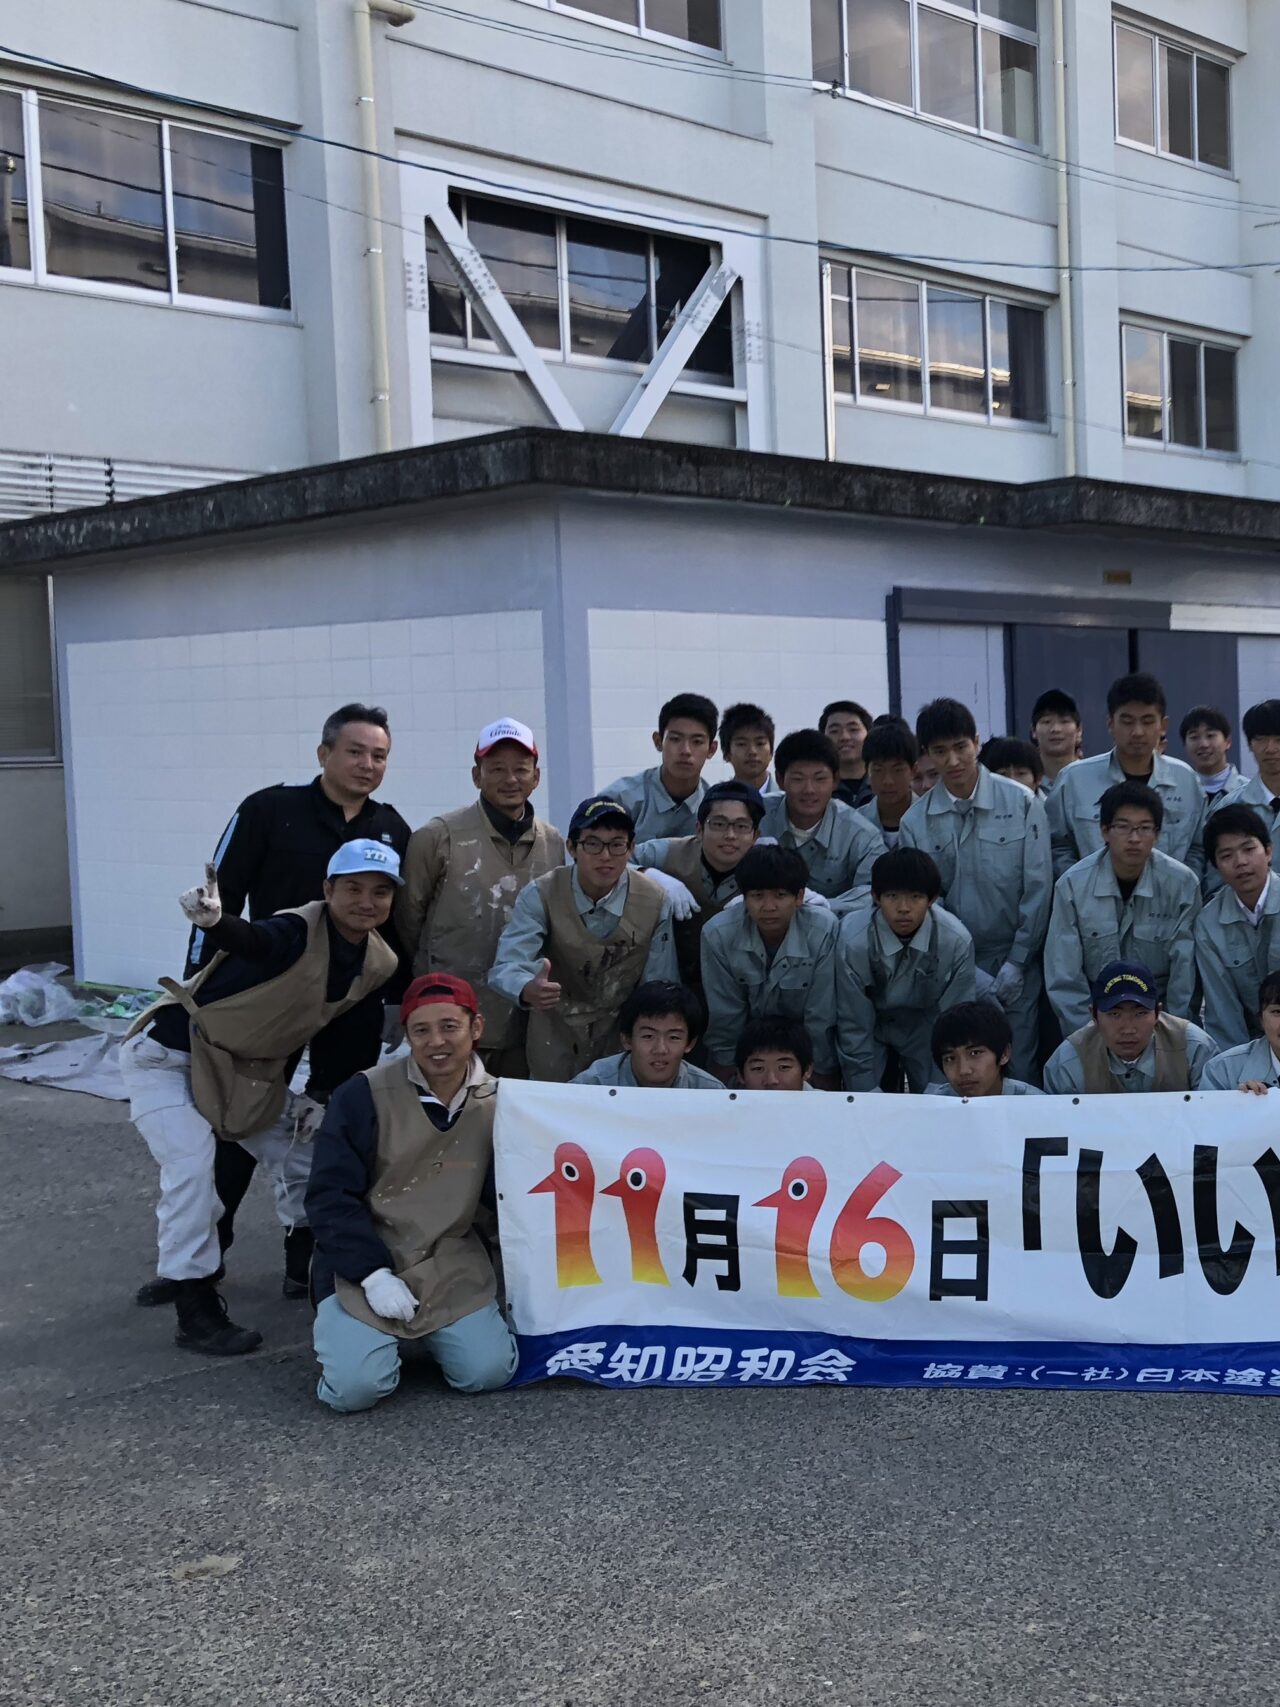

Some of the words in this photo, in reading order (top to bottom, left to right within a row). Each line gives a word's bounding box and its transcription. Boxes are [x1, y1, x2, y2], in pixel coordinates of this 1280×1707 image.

[546, 1342, 858, 1383] 愛知昭和会
